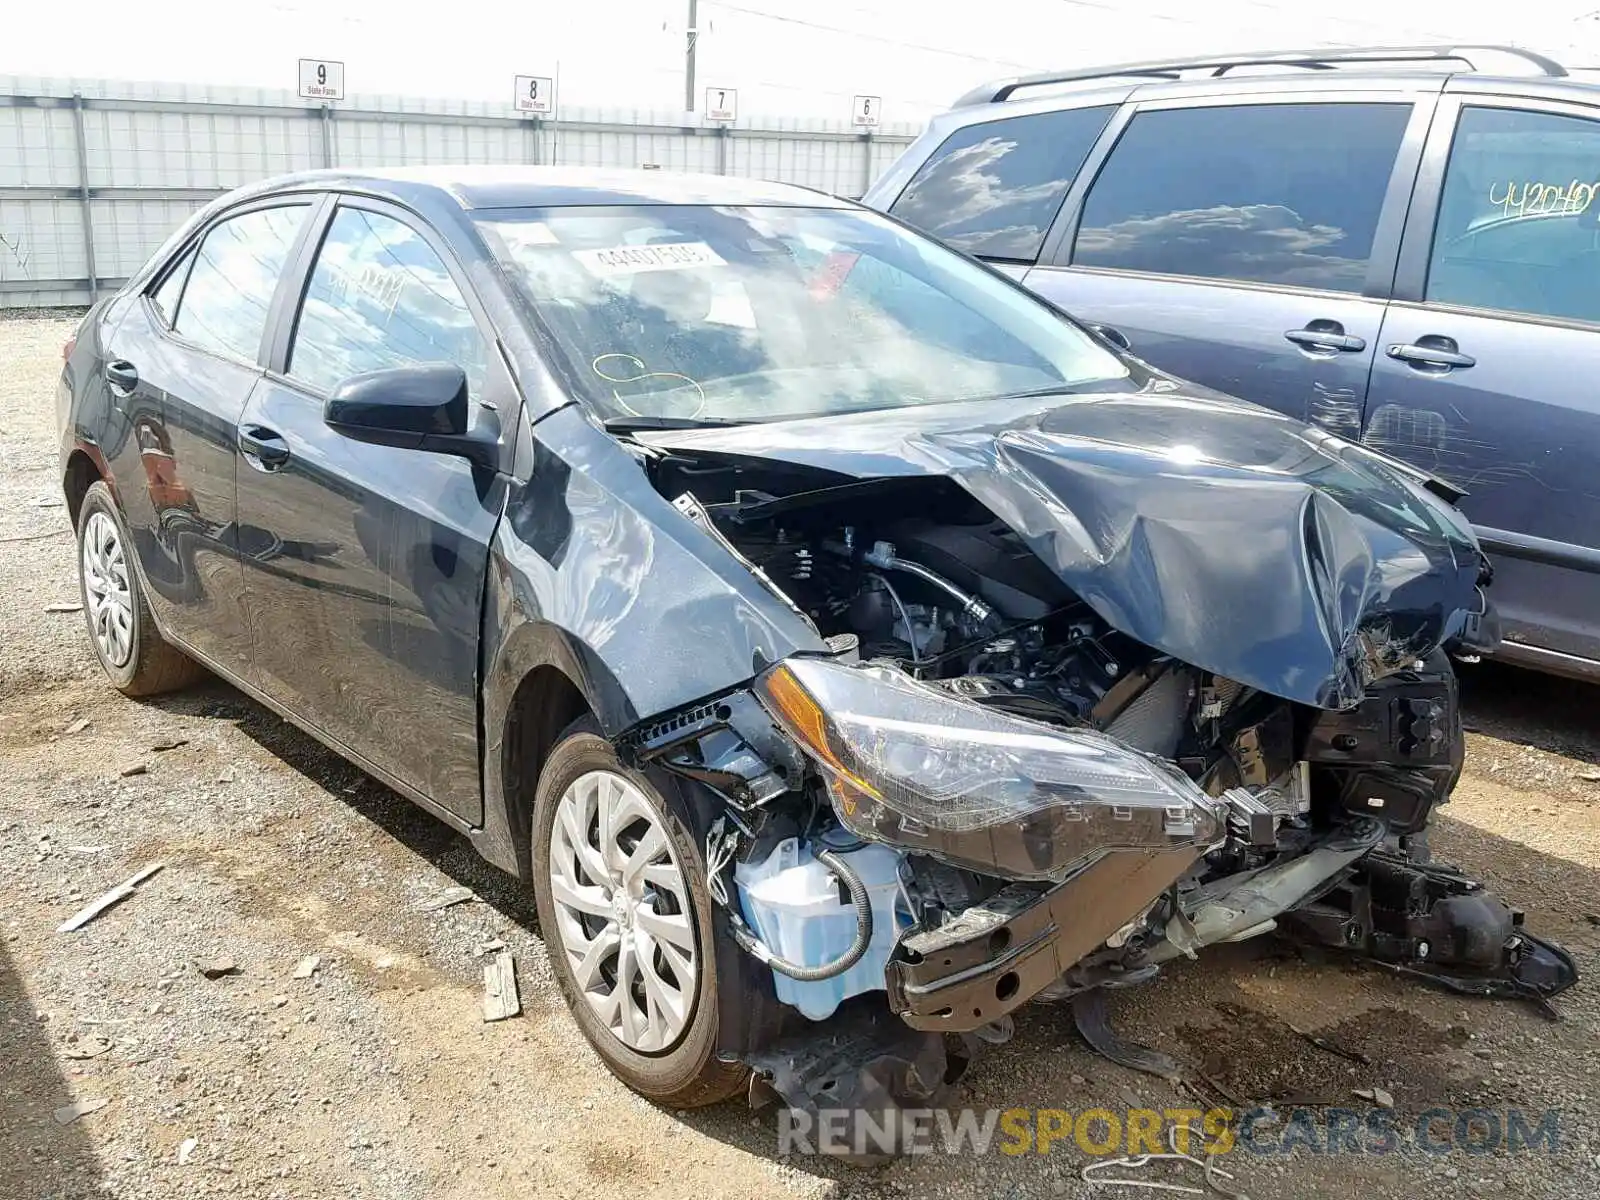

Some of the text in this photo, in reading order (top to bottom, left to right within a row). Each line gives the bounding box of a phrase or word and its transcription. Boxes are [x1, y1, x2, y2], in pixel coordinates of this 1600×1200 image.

[317, 63, 327, 85] 9
[529, 80, 538, 100] 8
[718, 91, 726, 109] 7
[863, 98, 871, 116] 6
[1489, 179, 1600, 218] 442040
